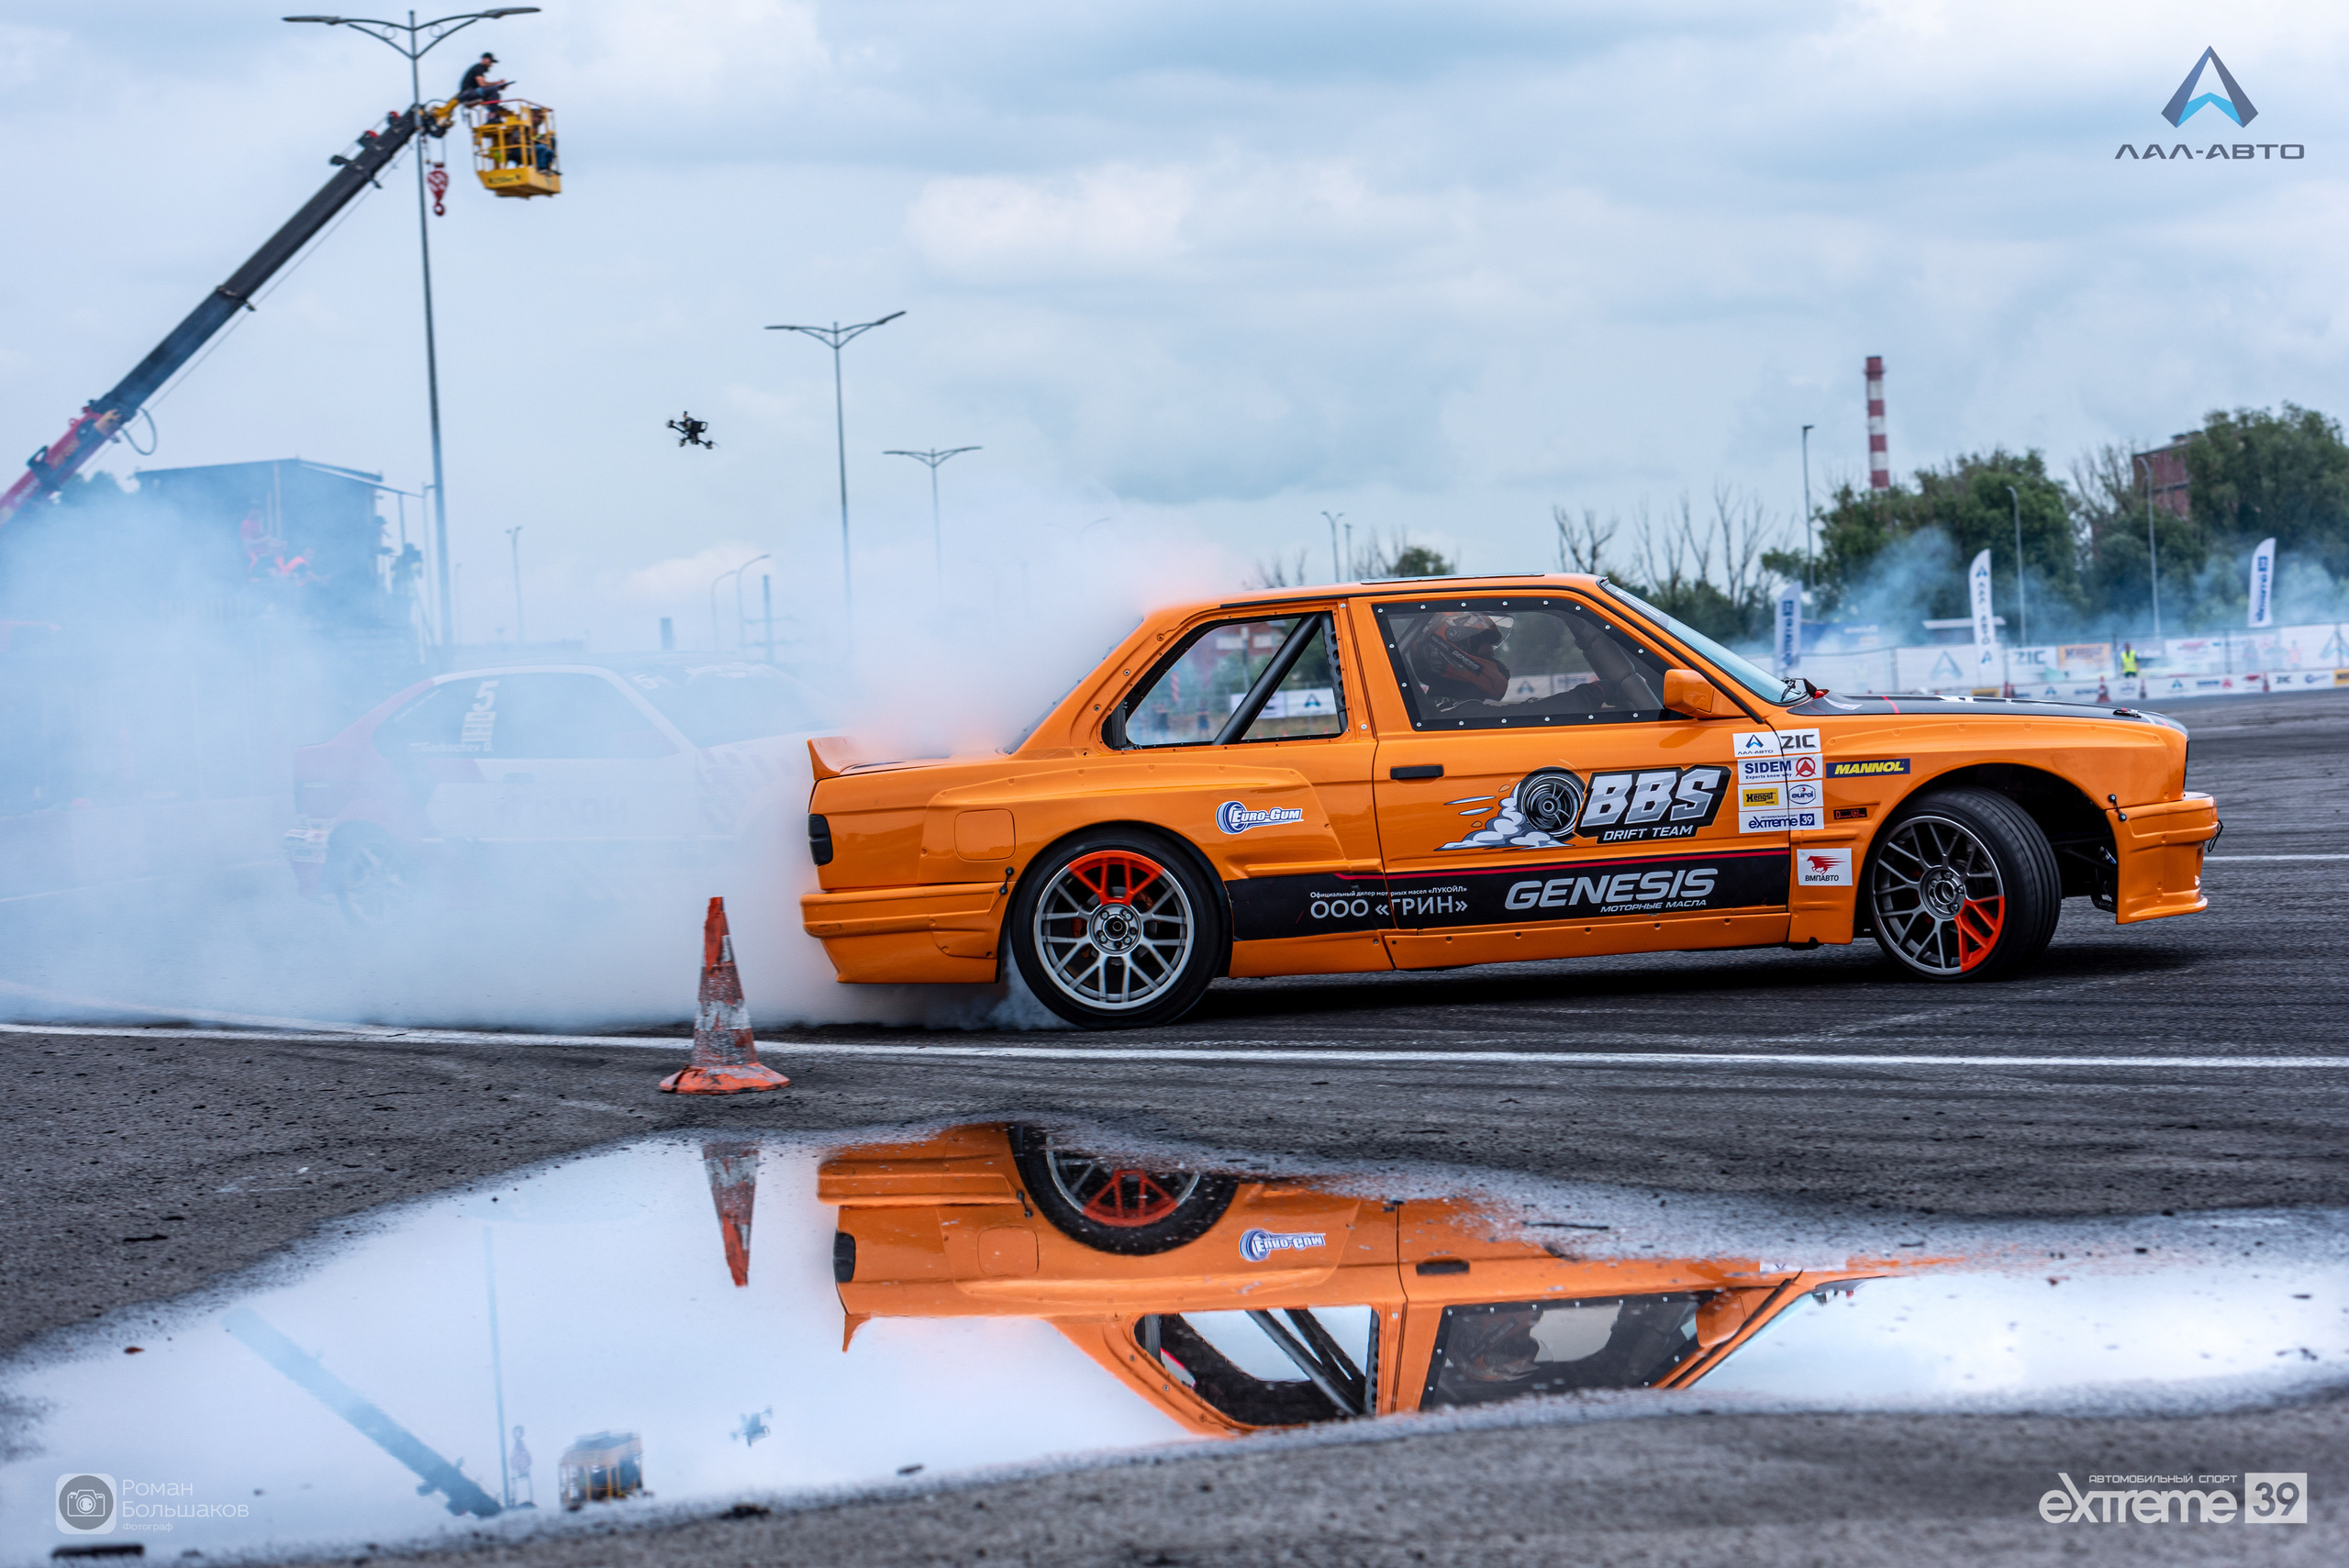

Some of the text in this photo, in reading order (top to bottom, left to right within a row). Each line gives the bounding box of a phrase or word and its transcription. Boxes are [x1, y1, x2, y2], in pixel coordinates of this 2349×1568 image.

[2014, 651, 2046, 665] ZIC
[472, 681, 500, 713] 5
[1780, 734, 1817, 749] ZIC
[1744, 760, 1792, 774] SIDEM
[1834, 762, 1905, 775] MANNOL
[1580, 768, 1721, 828] BBS
[1746, 792, 1774, 803] Hengst
[1791, 791, 1814, 799] eurol
[1801, 815, 1813, 825] 39
[1603, 825, 1694, 841] DRIFT TEAM
[1805, 874, 1840, 883] ВМПАВТО
[1309, 890, 1356, 898] Официальный
[1428, 884, 1468, 895] «ЛУКОЙЛ»
[1504, 868, 1719, 910] GENESIS
[1310, 898, 1369, 919] ООО
[1600, 899, 1707, 913] МОТОРНЫЕ МАСЛА
